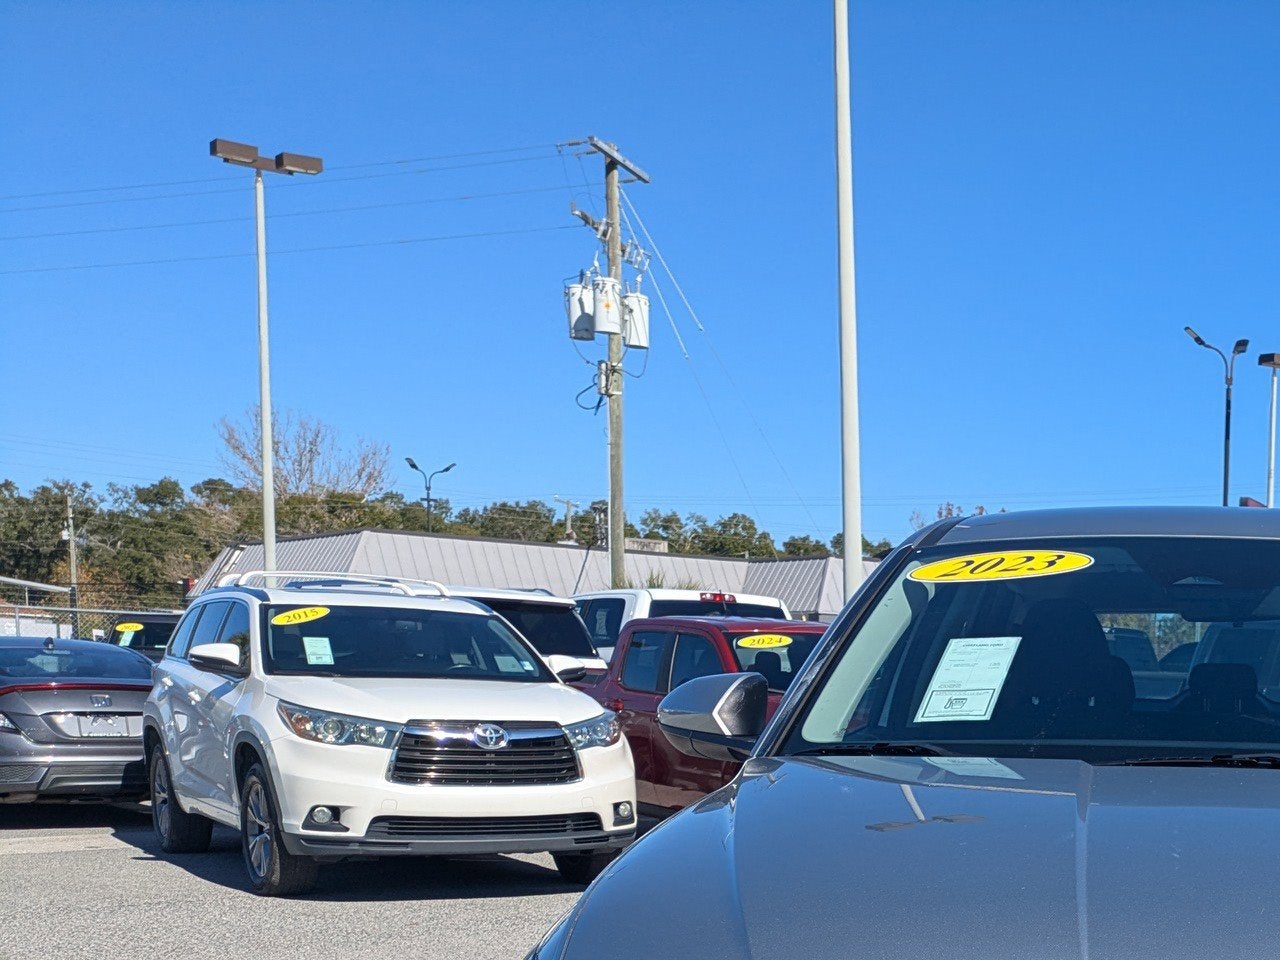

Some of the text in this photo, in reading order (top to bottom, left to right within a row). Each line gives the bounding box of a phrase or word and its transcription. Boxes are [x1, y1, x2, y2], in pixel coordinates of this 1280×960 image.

[934, 555, 1065, 578] 2023
[283, 608, 319, 623] 2015
[749, 637, 783, 646] 2024
